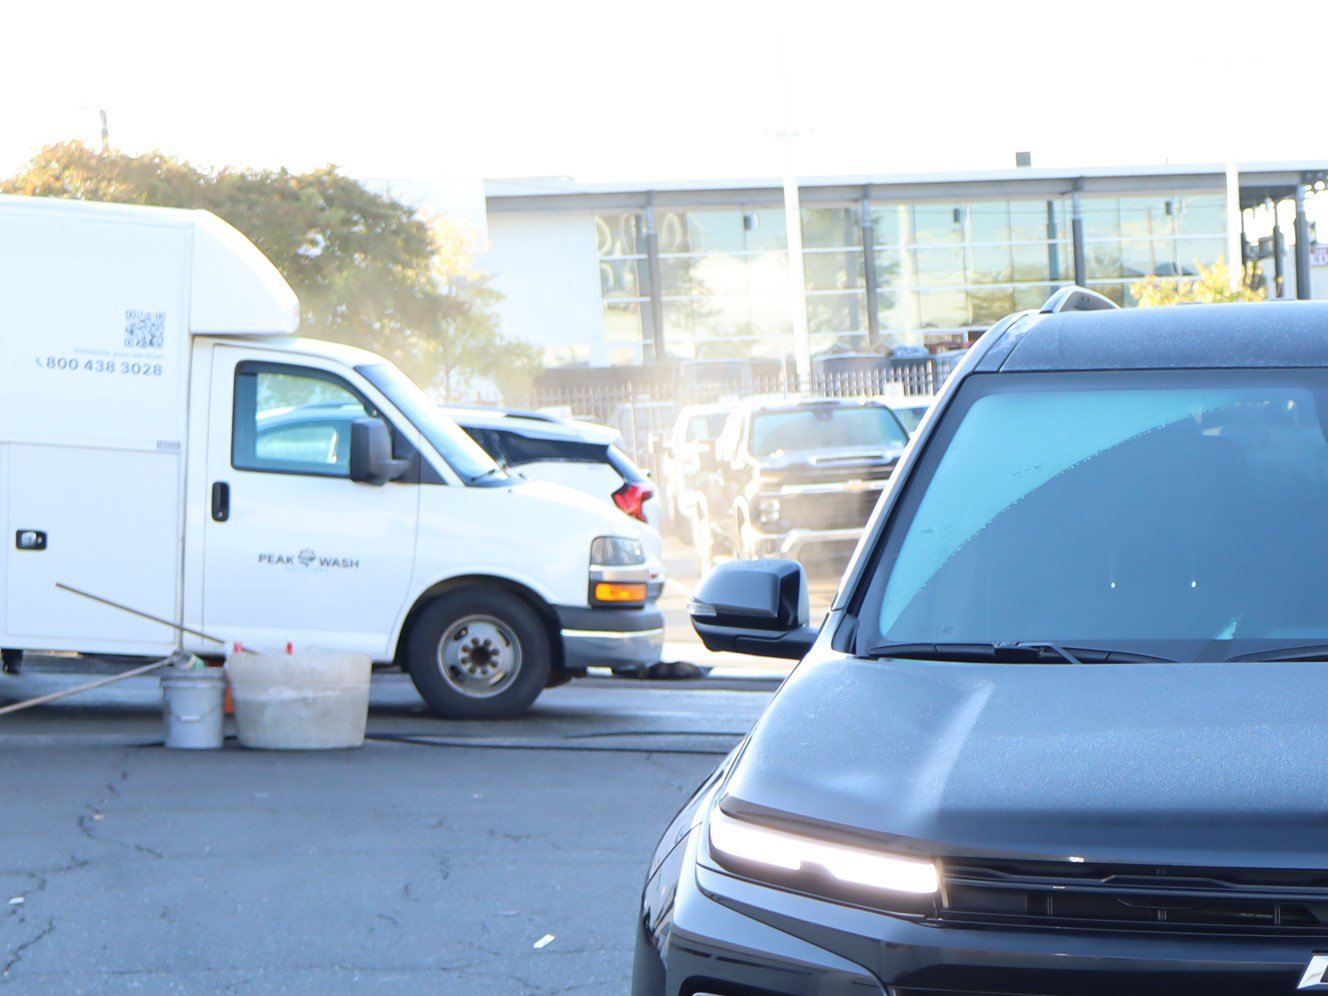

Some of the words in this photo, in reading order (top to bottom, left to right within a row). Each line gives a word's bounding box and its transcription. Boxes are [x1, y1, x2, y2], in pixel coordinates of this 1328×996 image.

[46, 356, 79, 370] 800
[84, 359, 115, 373] 438
[120, 361, 163, 377] 3028
[258, 553, 294, 565] PEAK
[319, 557, 360, 569] WASH
